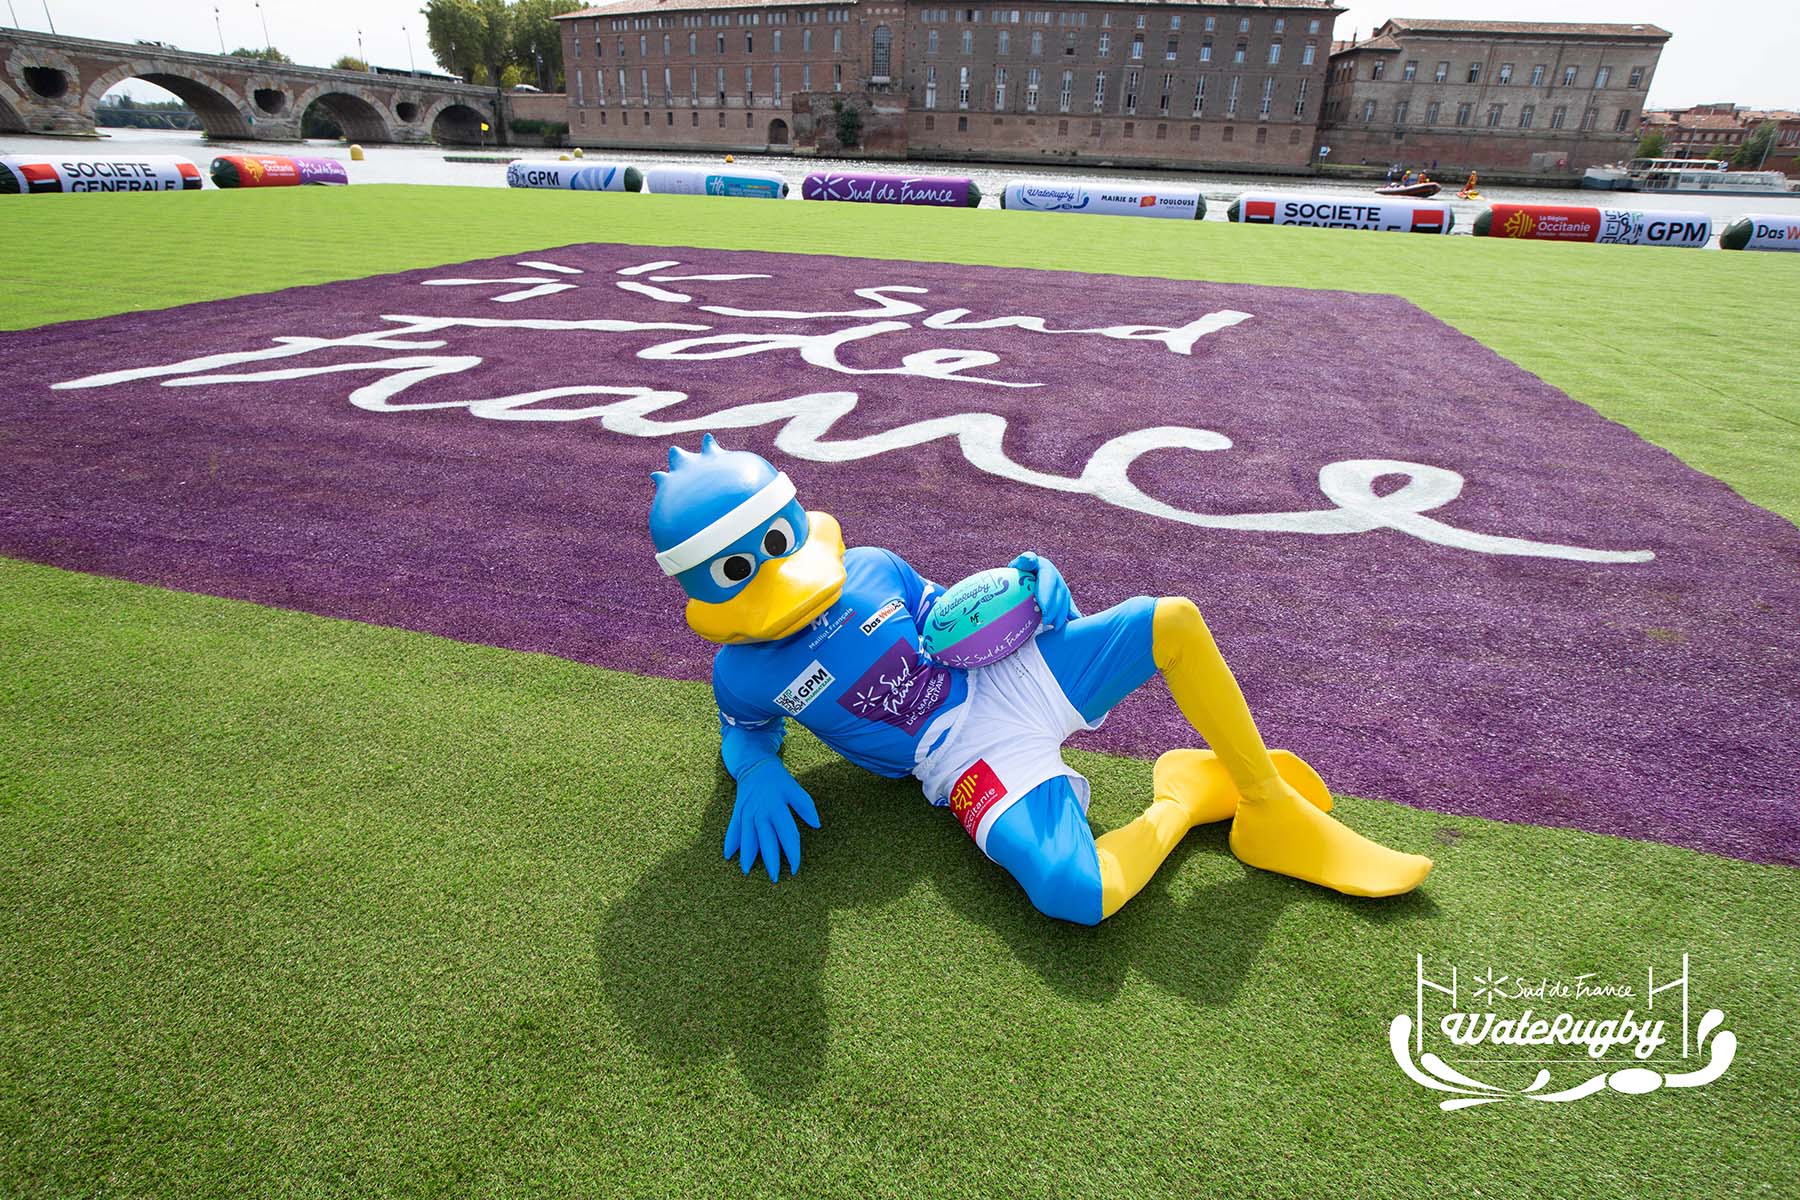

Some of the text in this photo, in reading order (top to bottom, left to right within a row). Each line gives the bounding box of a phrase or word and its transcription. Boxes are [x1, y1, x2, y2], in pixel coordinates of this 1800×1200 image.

[62, 162, 157, 178] SOCIETE
[528, 171, 560, 186] GPM
[843, 178, 956, 202] Sud de France
[1159, 198, 1194, 206] TOULOUSE
[1284, 203, 1381, 221] SOCIETE
[1537, 221, 1591, 231] Occitanie
[1647, 221, 1707, 241] GPM
[1757, 224, 1784, 239] Das
[699, 285, 1255, 355] Sud
[51, 313, 1656, 564] France
[862, 616, 882, 634] Das
[974, 648, 993, 663] Sud
[798, 668, 828, 698] GPM
